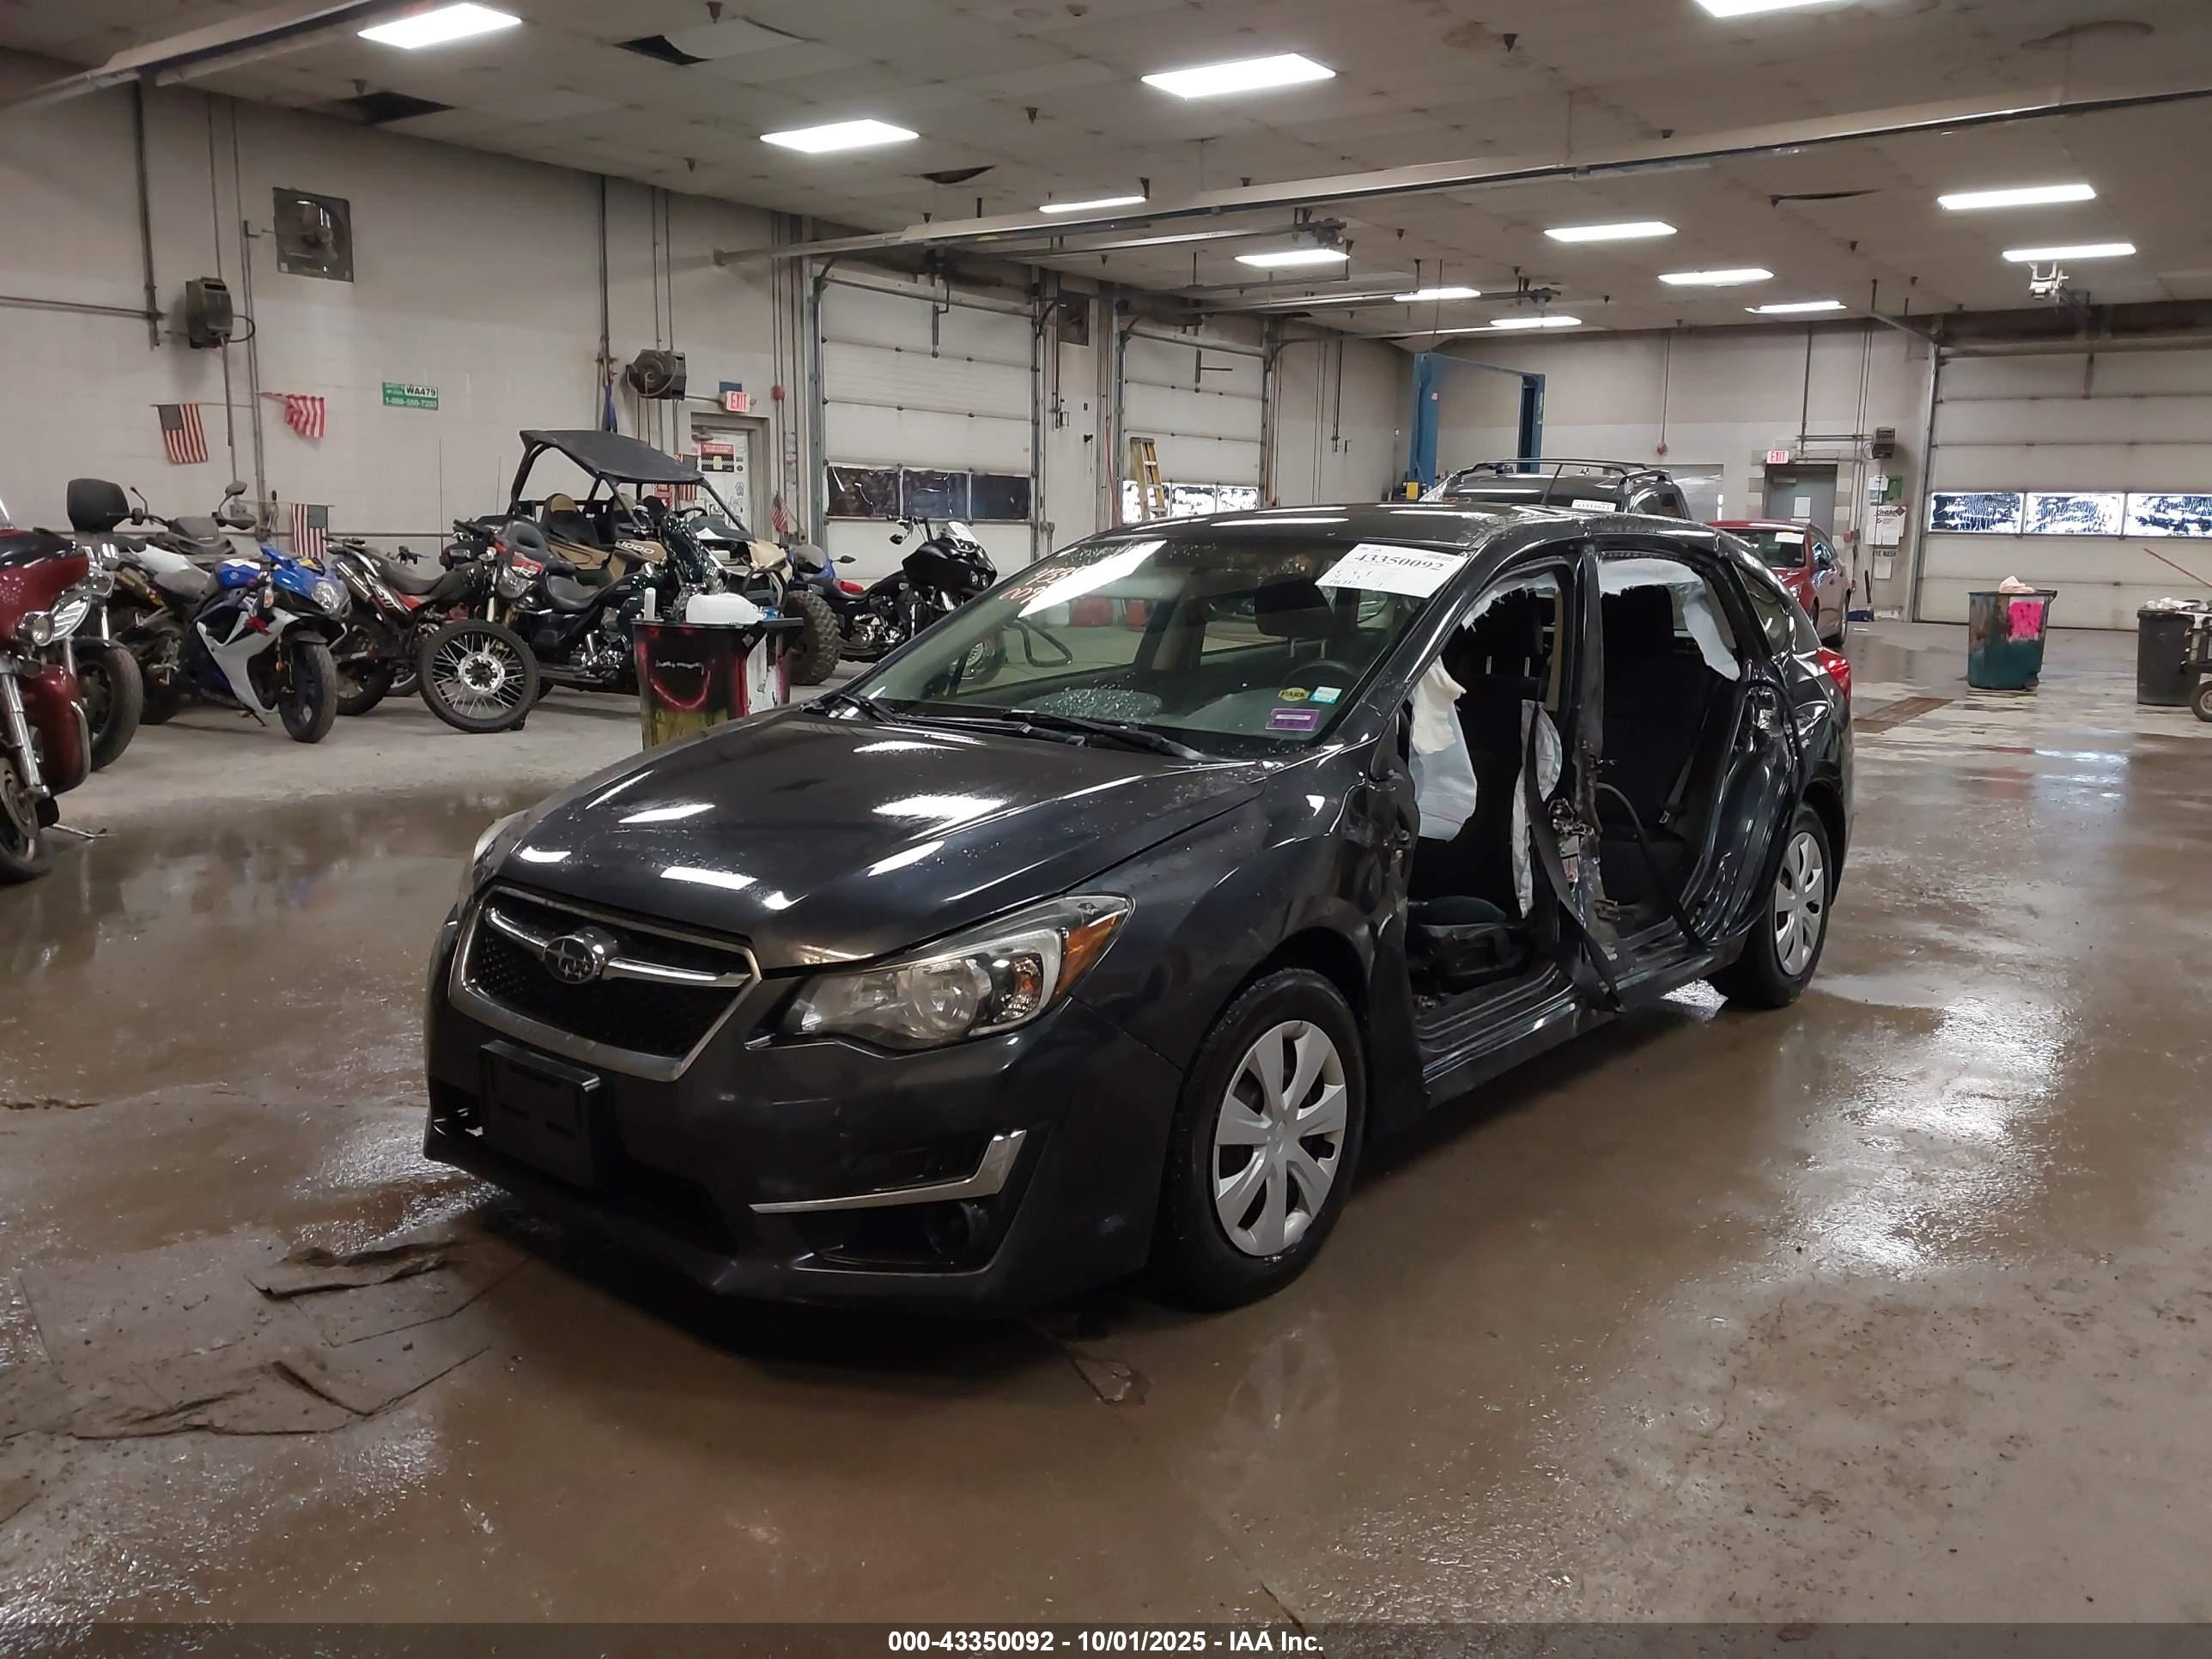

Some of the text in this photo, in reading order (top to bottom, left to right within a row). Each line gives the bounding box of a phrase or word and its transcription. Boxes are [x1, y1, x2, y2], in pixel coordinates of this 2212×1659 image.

[406, 386, 436, 397] WA479
[730, 392, 748, 410] EXIT
[1771, 451, 1786, 462] EXIT
[621, 541, 655, 555] 1000
[1355, 554, 1444, 571] 43350092
